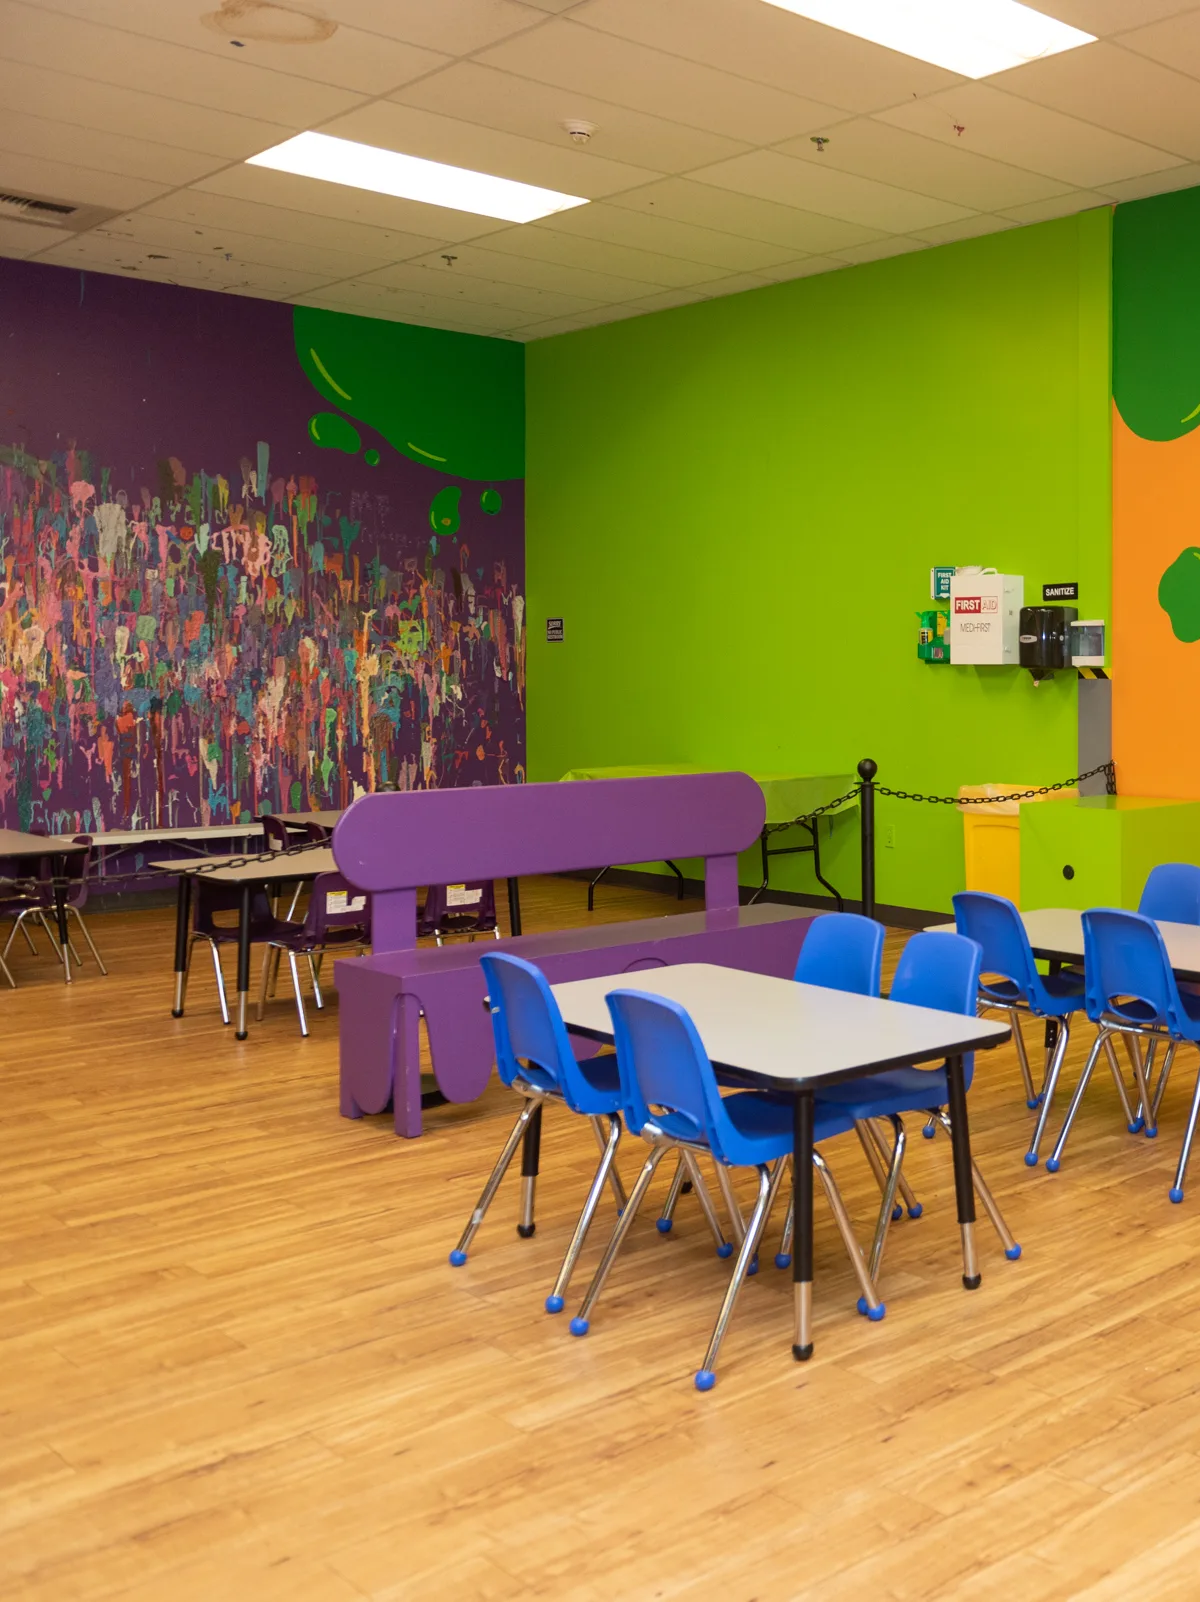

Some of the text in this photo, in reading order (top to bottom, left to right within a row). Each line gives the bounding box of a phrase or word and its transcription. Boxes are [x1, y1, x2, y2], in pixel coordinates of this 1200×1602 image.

[1045, 587, 1075, 597] SANITIZE
[955, 599, 997, 611] FIRST AID
